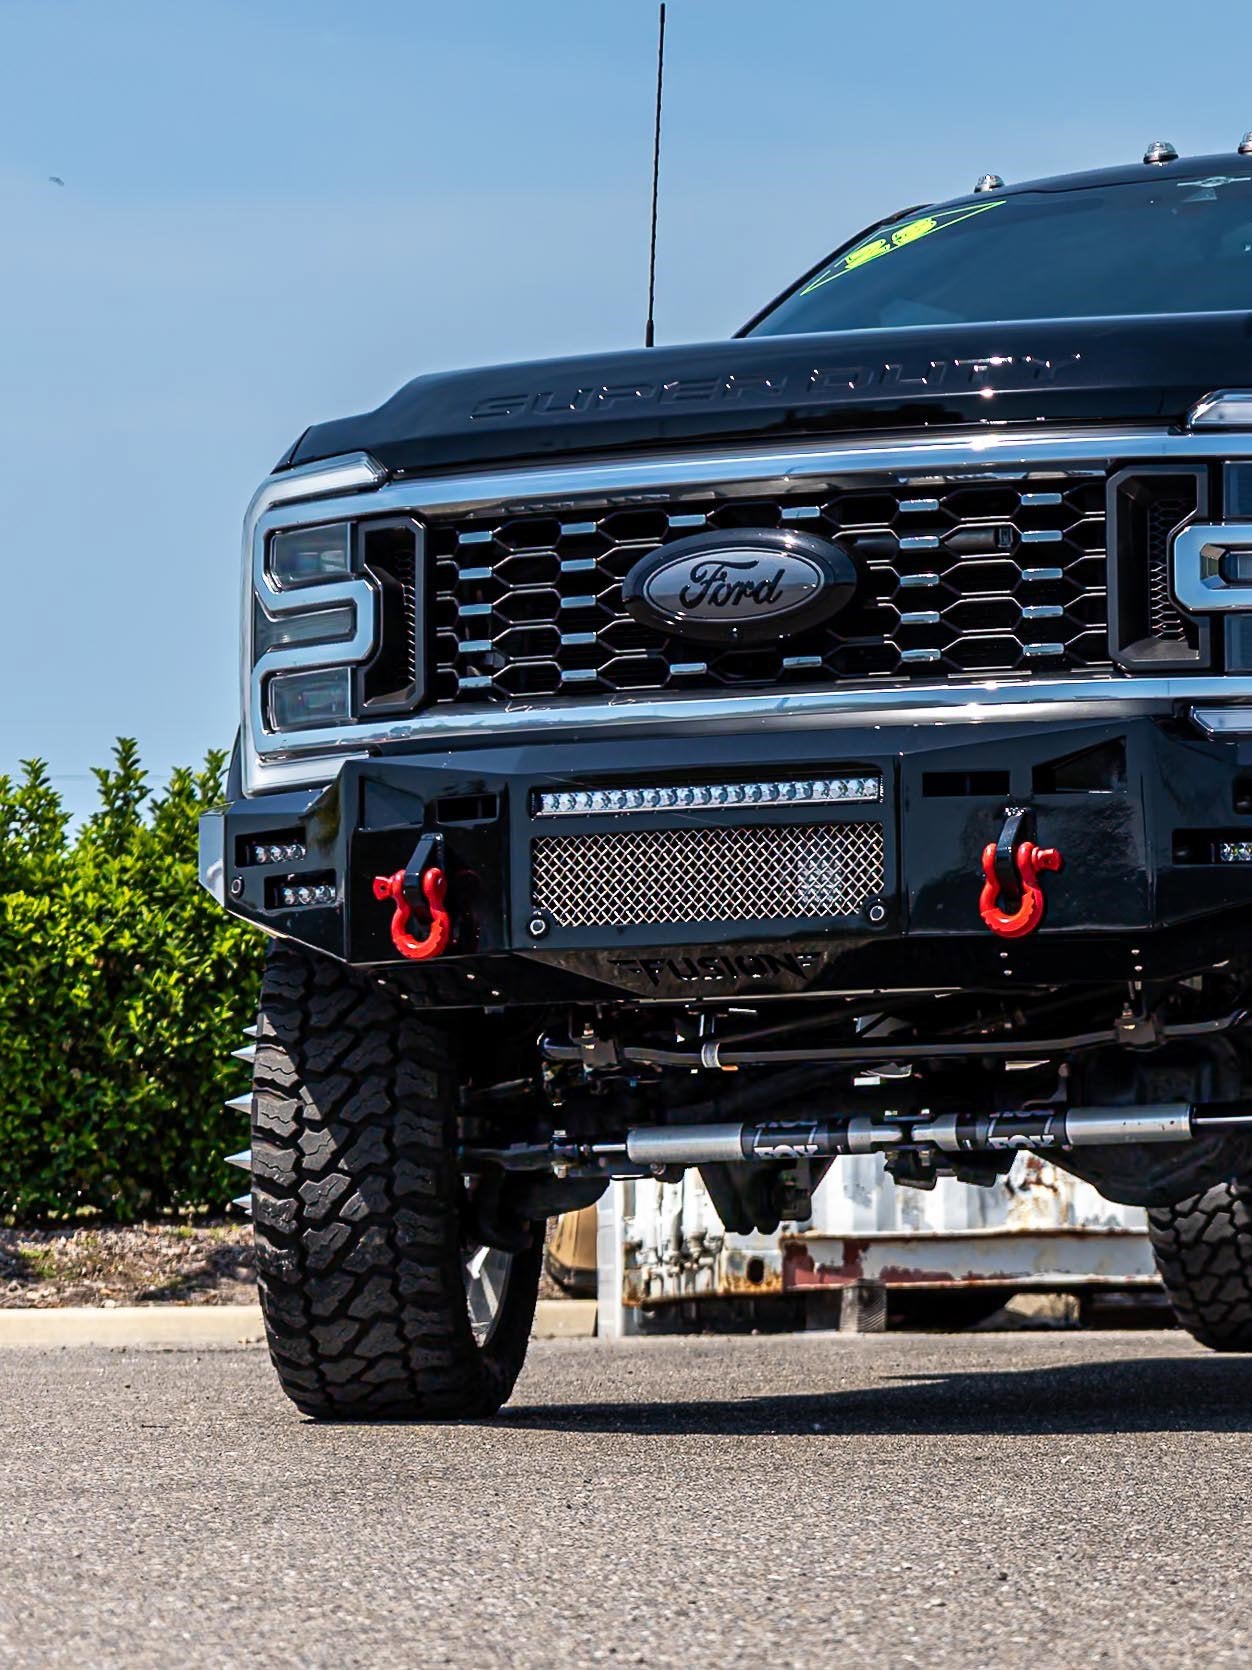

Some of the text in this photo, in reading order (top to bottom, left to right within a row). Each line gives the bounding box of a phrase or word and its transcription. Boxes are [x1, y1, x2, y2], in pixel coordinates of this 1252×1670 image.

[470, 353, 1081, 420] SUPER DUTY
[679, 559, 786, 610] Ford
[632, 951, 811, 987] FUSION
